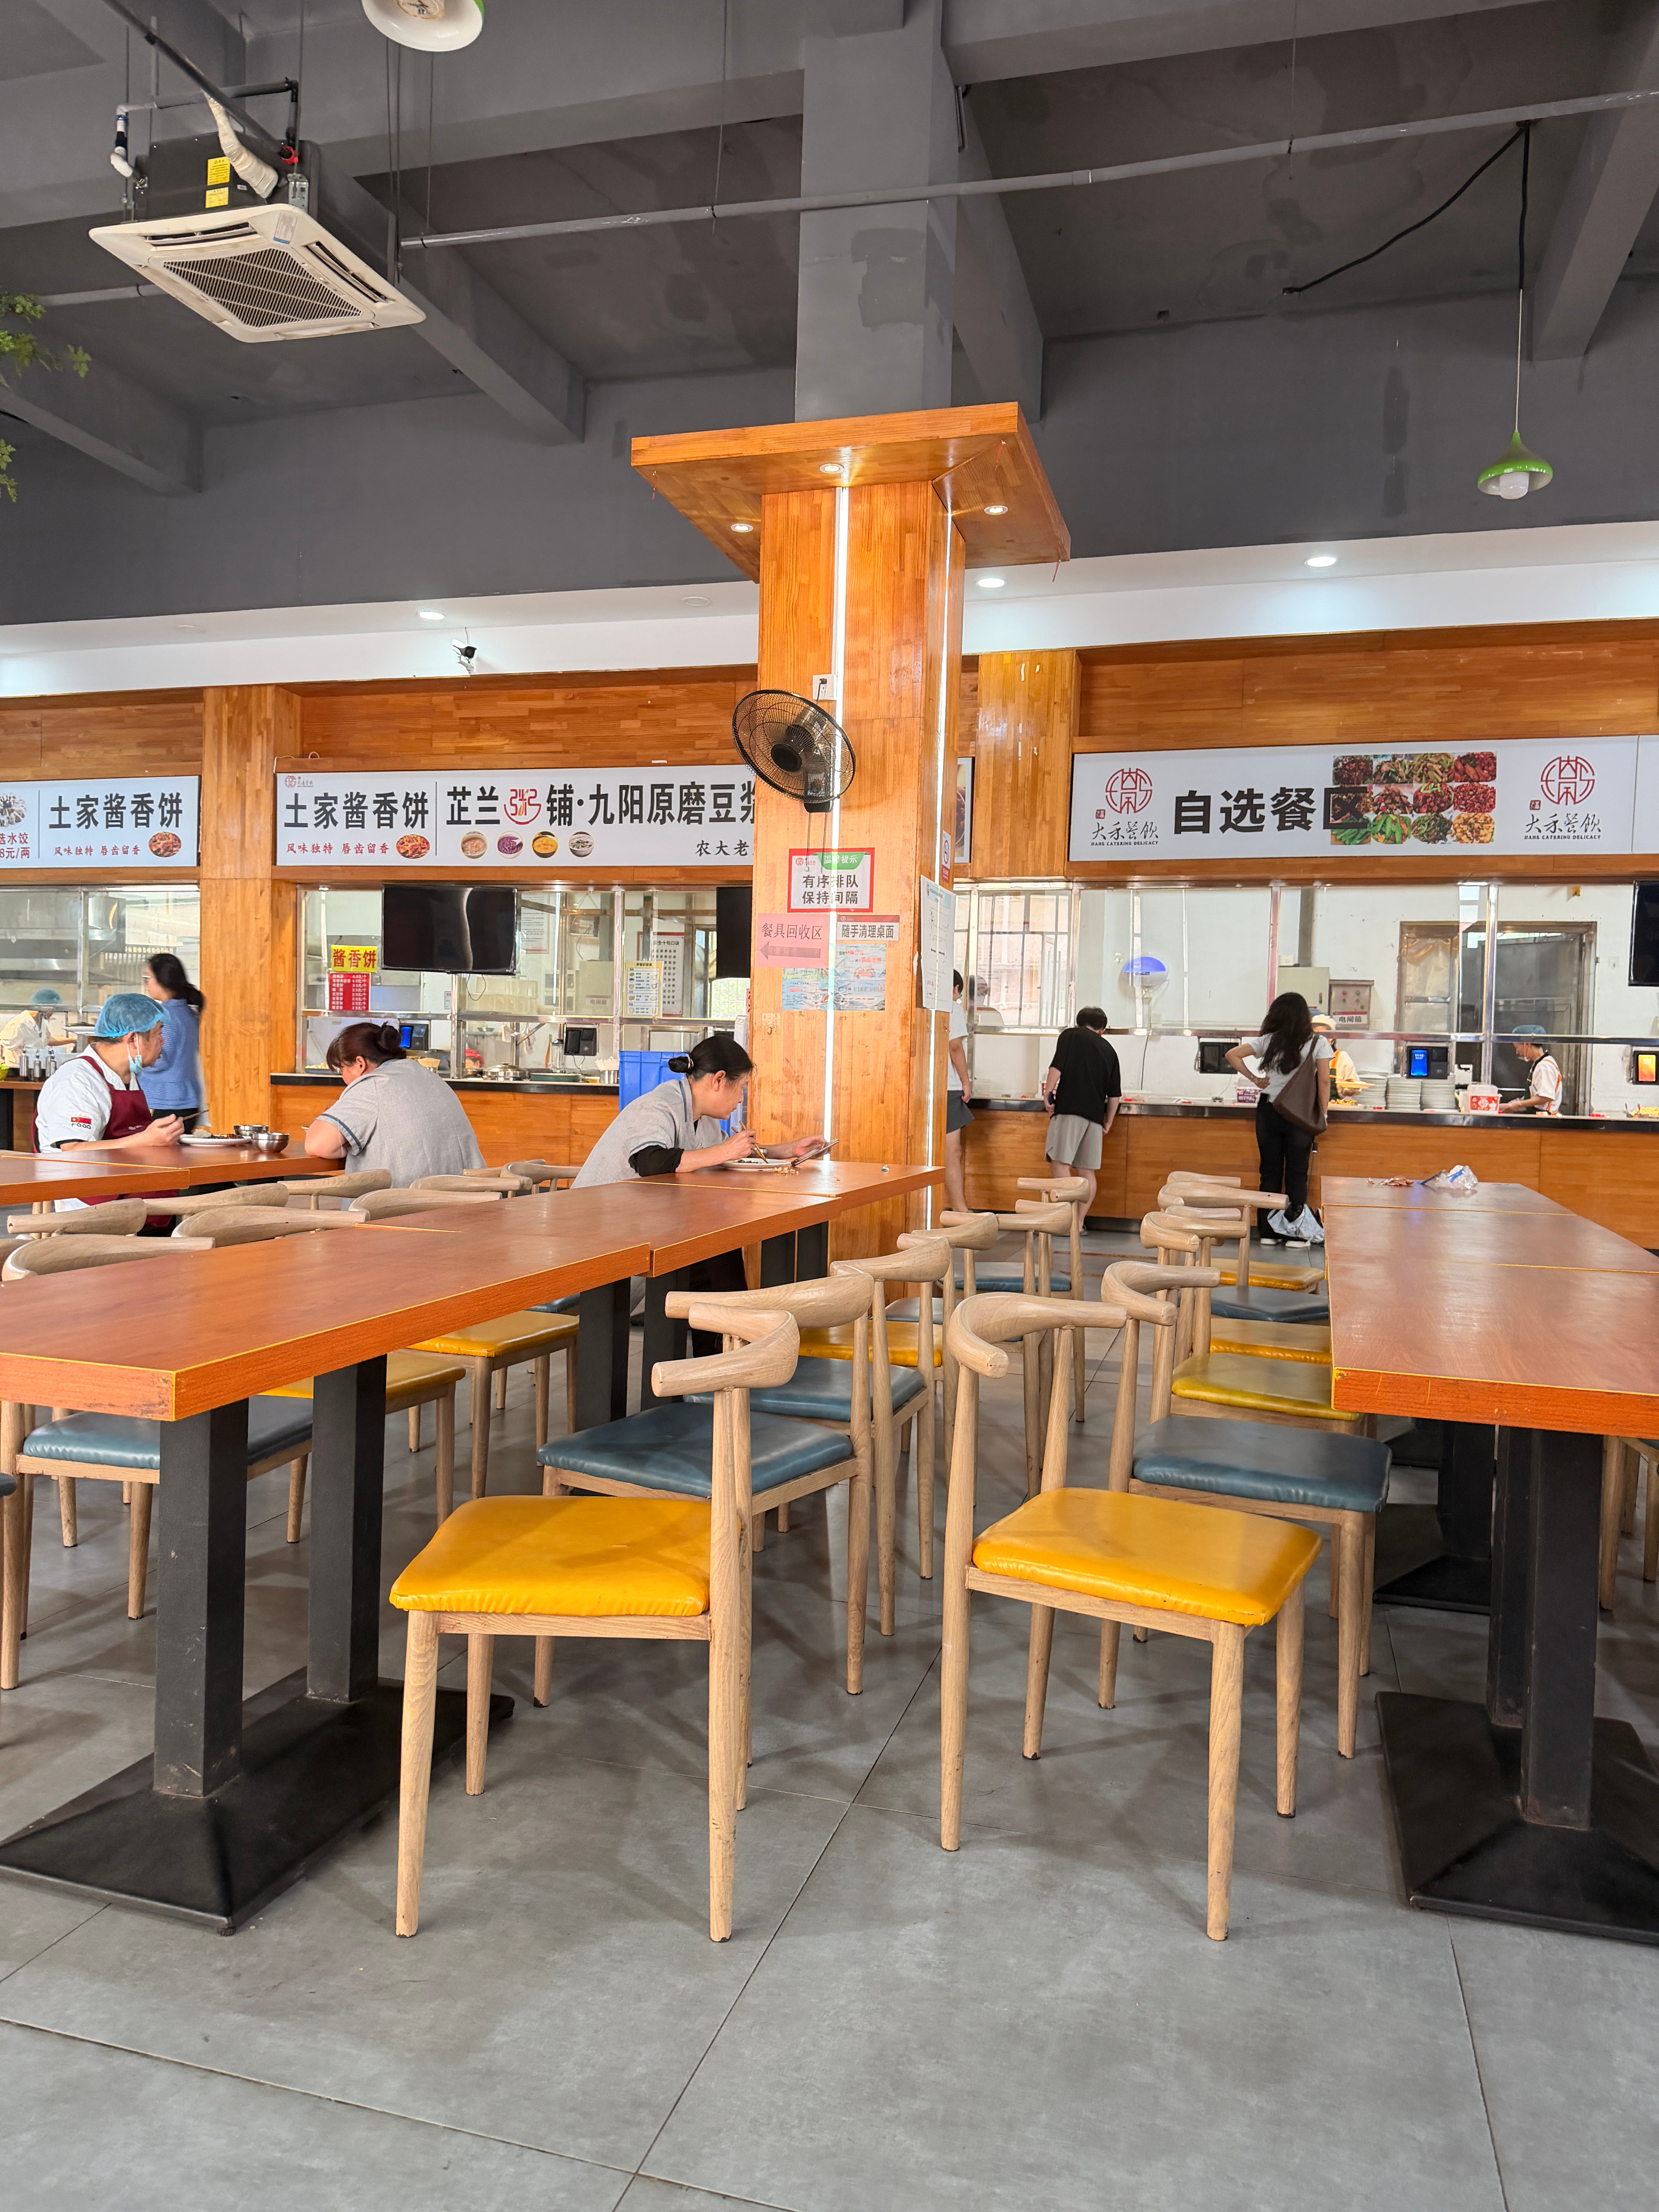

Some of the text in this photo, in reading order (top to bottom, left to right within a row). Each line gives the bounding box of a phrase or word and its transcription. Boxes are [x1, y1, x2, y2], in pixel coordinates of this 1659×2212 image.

[49, 792, 182, 829] 土家酱香饼
[284, 791, 429, 829] 土家酱香饼
[1174, 787, 1367, 834] 自选餐区
[54, 845, 140, 856] 风味独特 唇齿留香
[286, 842, 389, 854] 风味独特 唇齿留香
[696, 840, 754, 857] 农大老
[803, 874, 859, 888] 有序排队
[802, 891, 858, 904] 保持间隔
[761, 922, 823, 939] 餐具回收区
[842, 924, 894, 938] 随手清理桌面
[333, 949, 376, 968] 酱香饼
